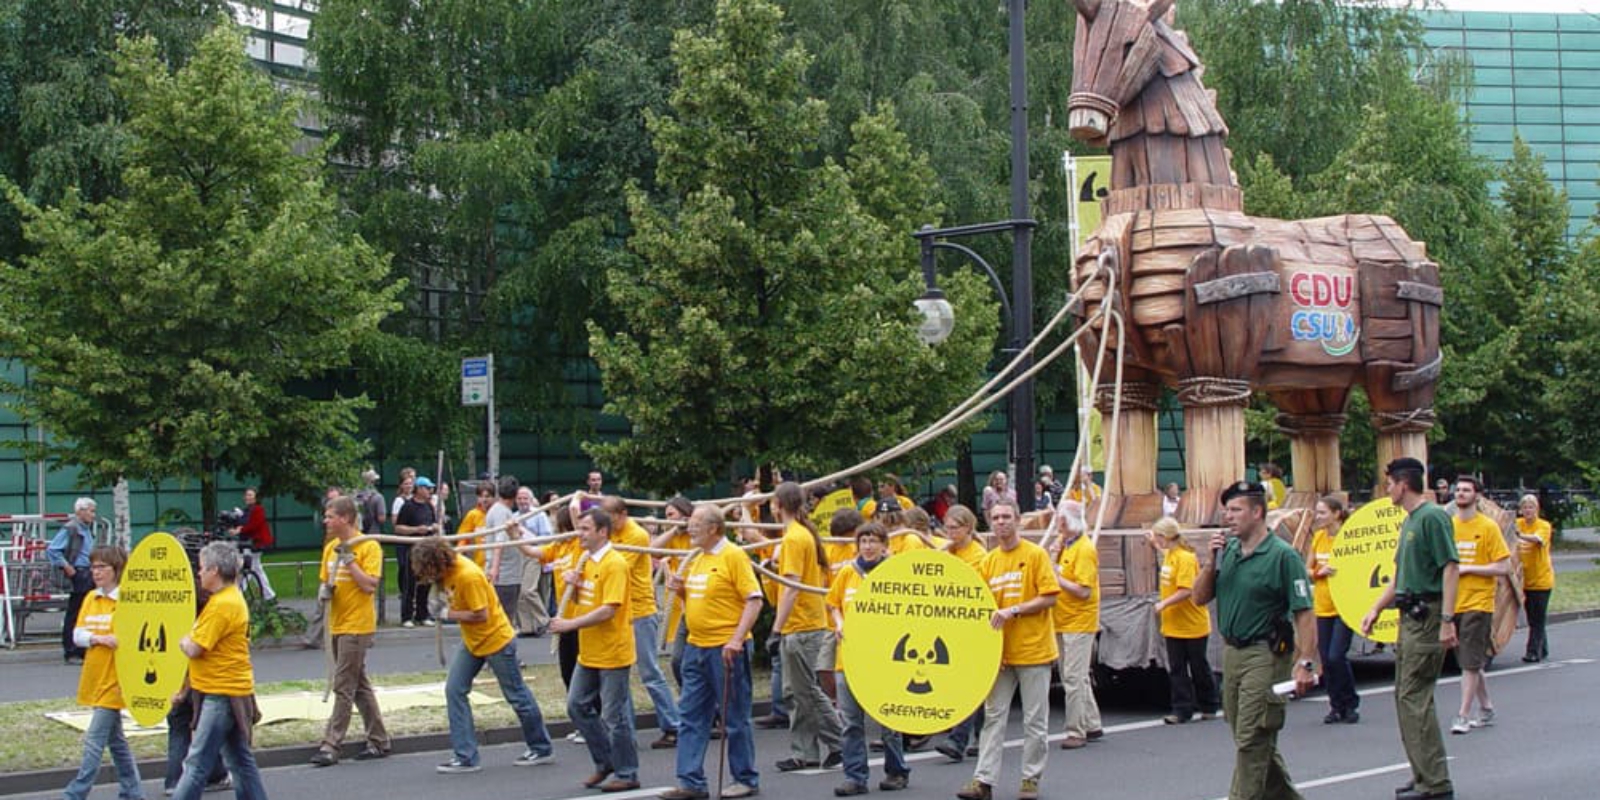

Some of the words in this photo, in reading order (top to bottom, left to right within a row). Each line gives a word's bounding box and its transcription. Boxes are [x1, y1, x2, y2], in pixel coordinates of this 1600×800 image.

[1291, 273, 1353, 307] CDU
[1291, 312, 1335, 339] CSU
[1375, 506, 1402, 519] WER
[1344, 524, 1392, 540] MERKEL
[150, 547, 167, 560] WER
[1333, 542, 1371, 558] WÄHLT
[128, 569, 157, 582] MERKEL
[912, 562, 944, 576] WER
[120, 588, 144, 604] WÄHLT
[145, 590, 192, 604] ATOMKRAFT
[870, 582, 929, 597] MERKEL
[933, 581, 985, 601] WÄHLT,
[855, 598, 902, 615] WÄHLT
[905, 604, 995, 621] ATOMKRAFT
[879, 703, 956, 720] GREENPEACE
